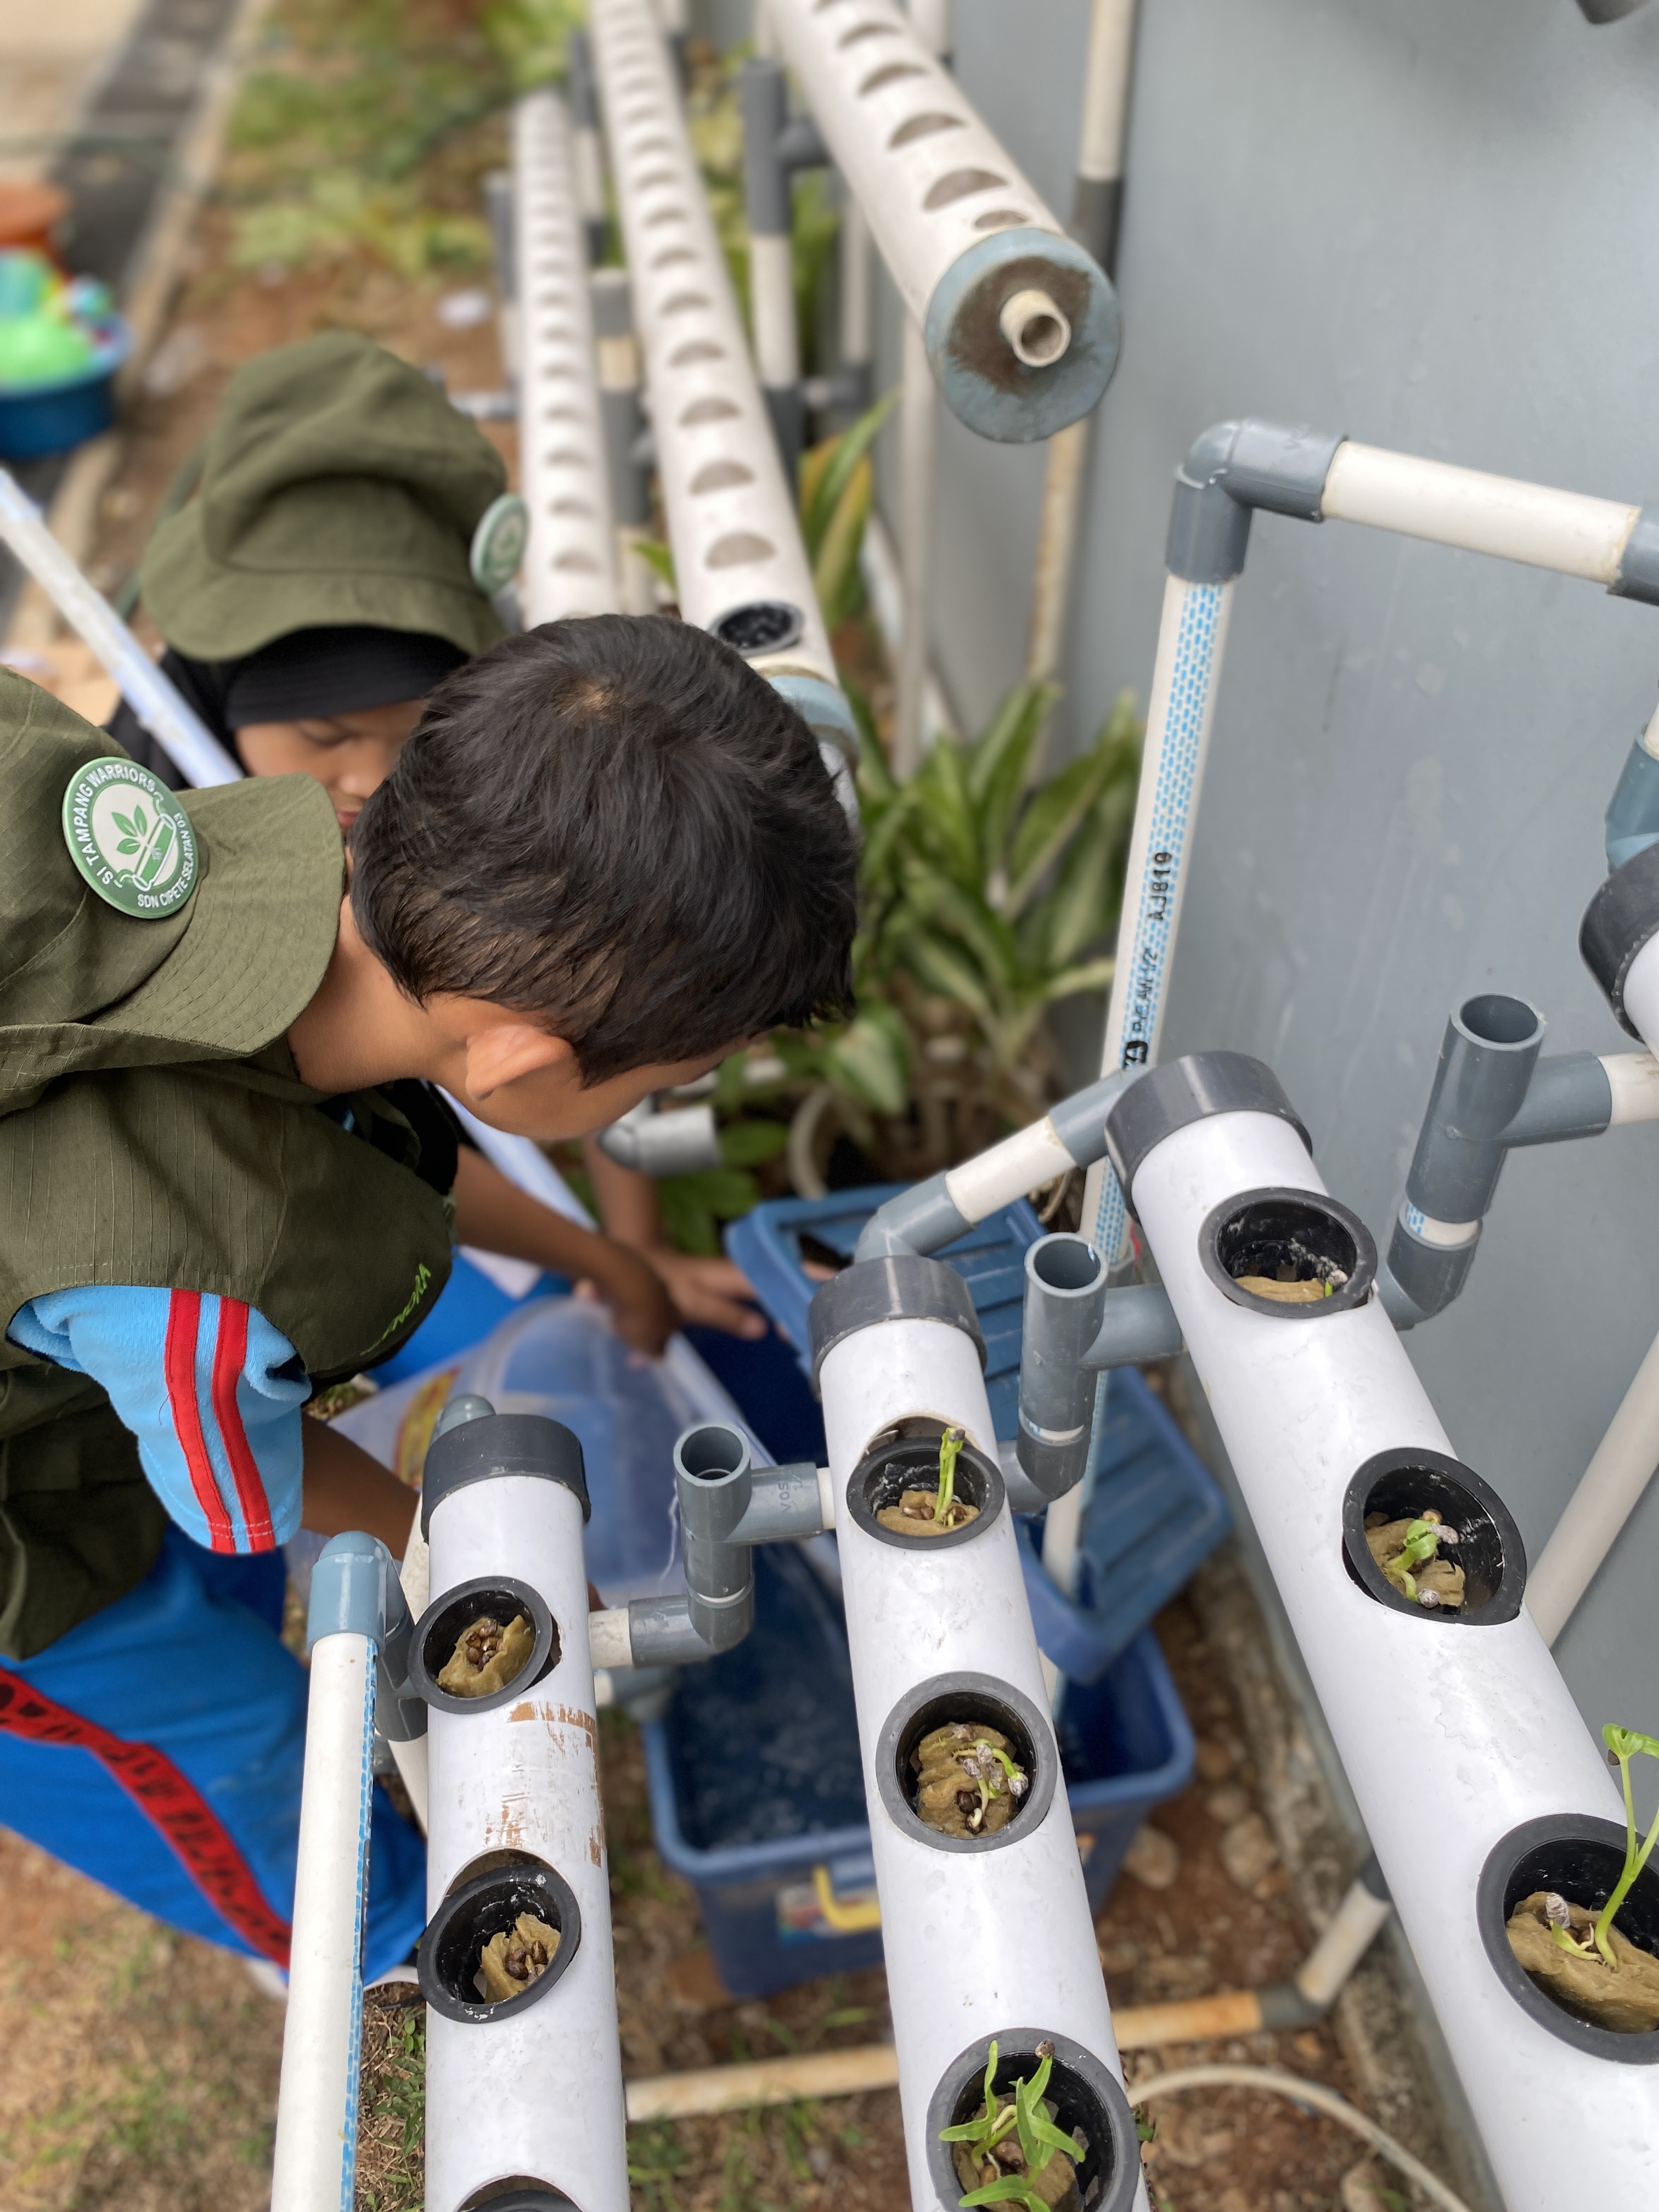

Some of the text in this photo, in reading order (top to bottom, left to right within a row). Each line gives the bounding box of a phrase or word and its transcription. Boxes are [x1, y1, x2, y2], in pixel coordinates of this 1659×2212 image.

[73, 764, 156, 885] SI TAMPANG WARRIORS
[137, 894, 160, 909] SDN
[160, 877, 188, 906] CIPETE
[180, 830, 194, 881] SELATAN
